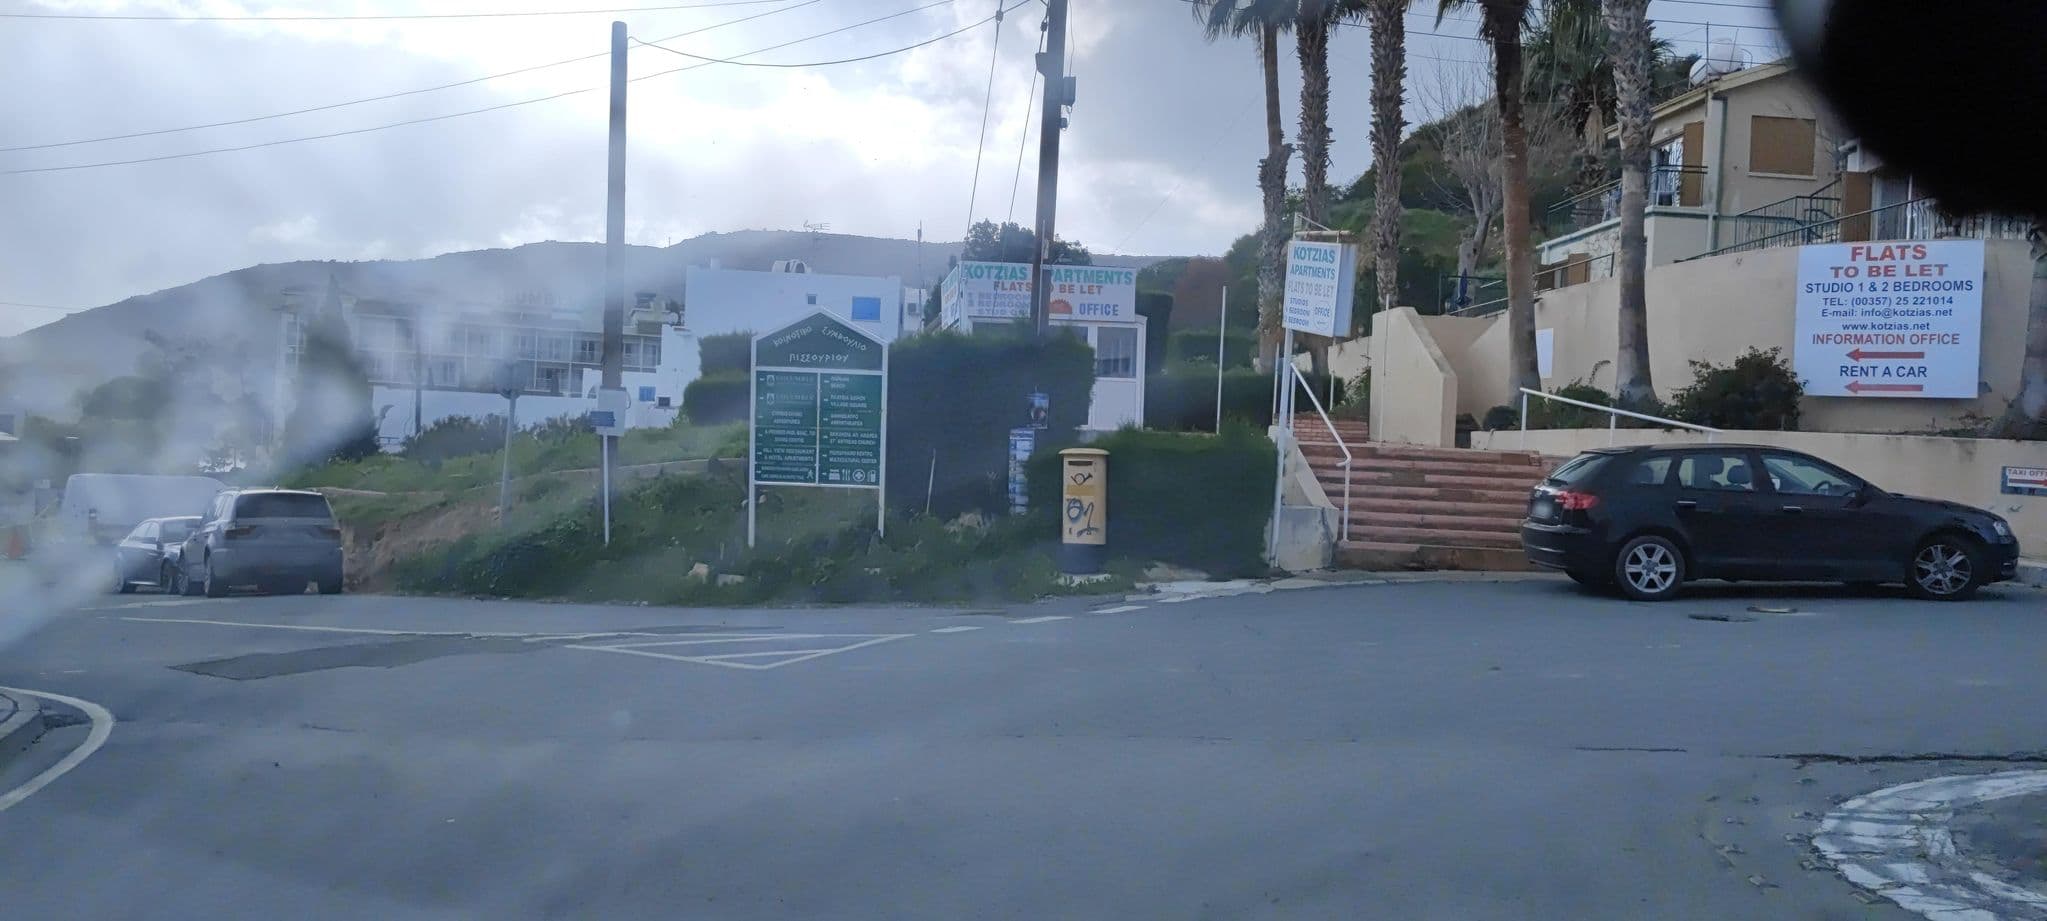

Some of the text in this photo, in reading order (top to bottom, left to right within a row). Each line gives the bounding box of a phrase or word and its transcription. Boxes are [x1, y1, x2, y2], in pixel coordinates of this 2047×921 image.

[1293, 246, 1335, 264] KOTZIAS
[1851, 245, 1927, 262] FLATS
[964, 264, 1133, 285] KOTZIAS ARTMENTS
[1290, 264, 1335, 280] APARTMENTS
[1830, 264, 1948, 278] TO BE LET
[994, 281, 1032, 292] FLATS
[1059, 285, 1075, 294] BE
[1080, 285, 1103, 295] LET
[1805, 280, 1973, 293] STUDIO 1 & 2 BEDROOMS
[1823, 297, 1953, 306] TEL: (00357) 25 221014
[1079, 304, 1119, 316] OFFICE
[1314, 306, 1330, 317] OFFICE
[1822, 308, 1952, 318] E-mail: info@kotzias.net
[1842, 322, 1930, 330] www.kotzias.net
[1812, 333, 1960, 345] INFORMATION OFFICE
[1839, 366, 1928, 378] RENT A CAR
